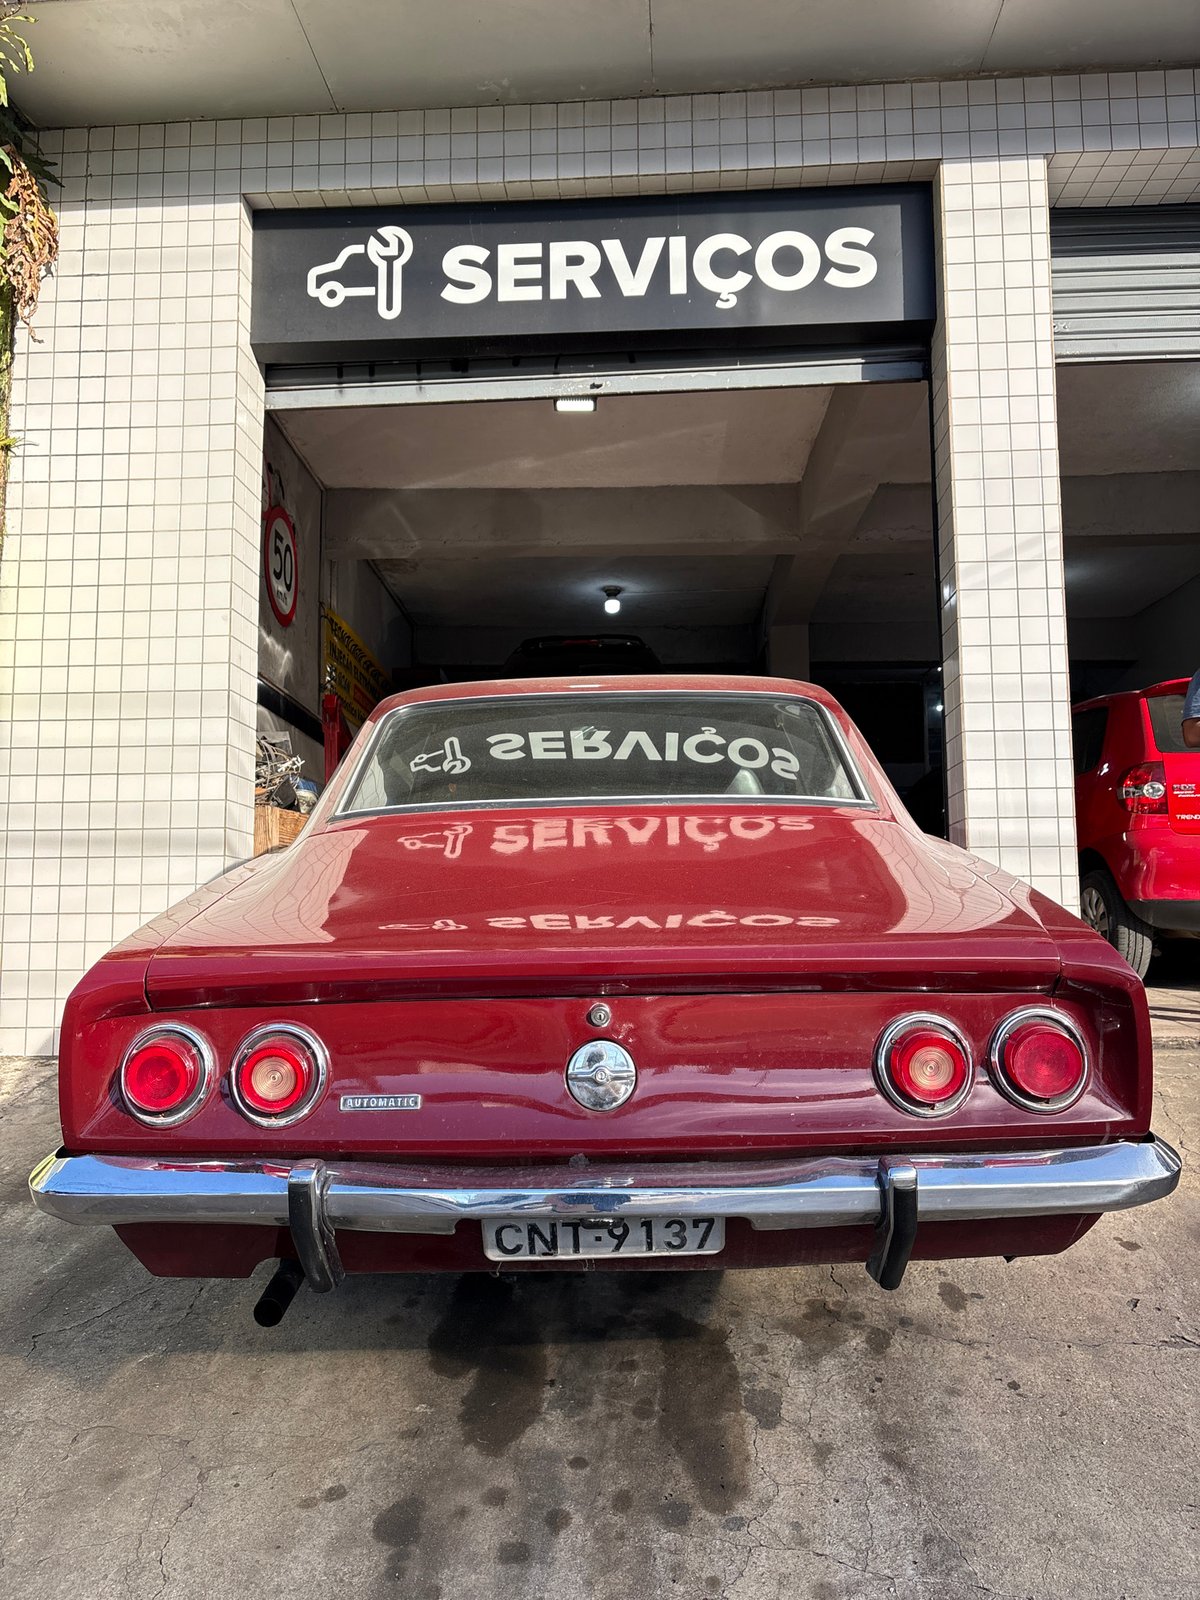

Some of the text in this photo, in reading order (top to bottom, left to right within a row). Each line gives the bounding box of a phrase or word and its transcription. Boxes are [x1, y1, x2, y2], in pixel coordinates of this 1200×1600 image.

[440, 227, 878, 309] SERVIÇOS
[273, 529, 293, 592] 50
[346, 1096, 415, 1107] AUTOMATIC
[494, 1217, 716, 1255] CNT-9137
